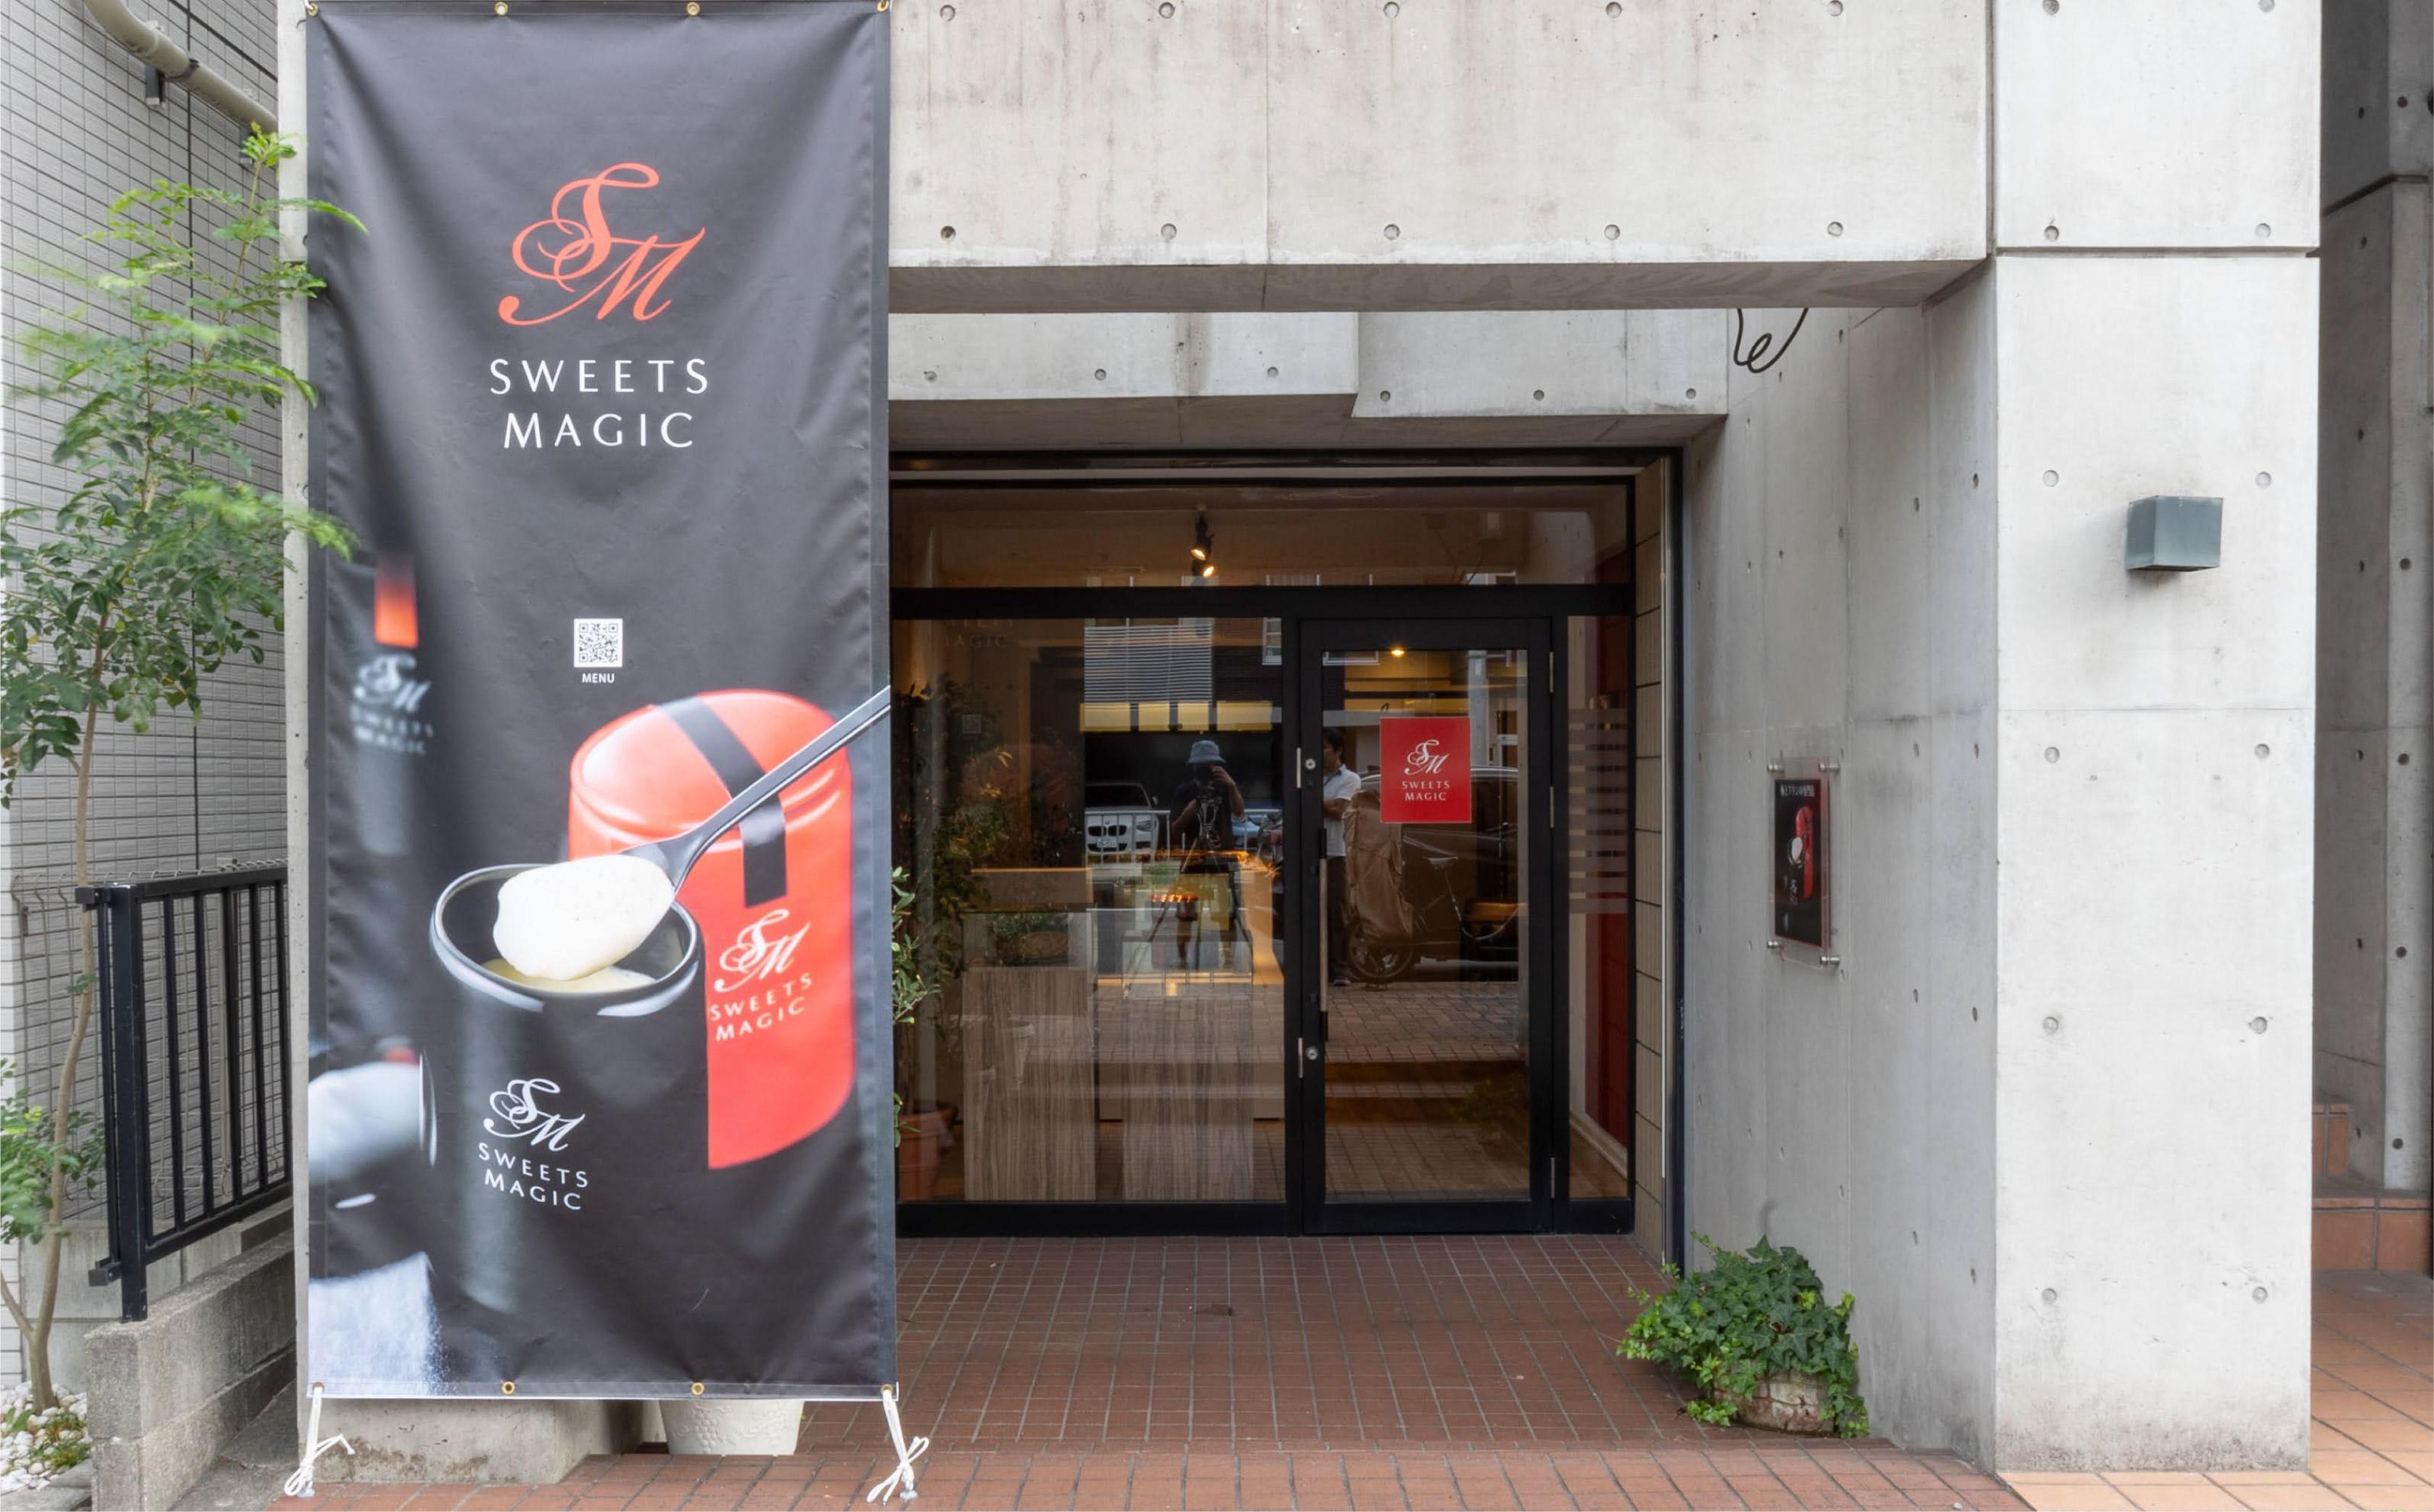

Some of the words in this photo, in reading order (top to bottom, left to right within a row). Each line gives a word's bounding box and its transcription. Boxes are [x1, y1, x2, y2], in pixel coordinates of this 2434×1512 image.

[490, 358, 708, 395] SWEETS
[503, 412, 693, 448] MAGIC
[581, 672, 615, 684] MENU
[1402, 781, 1450, 789] SWEETS
[1405, 792, 1447, 801] MAGIC
[707, 972, 813, 1022] SWEETS
[715, 996, 805, 1042] MAGIC
[478, 1142, 588, 1188] SWEETS
[484, 1168, 581, 1210] MAGIC
